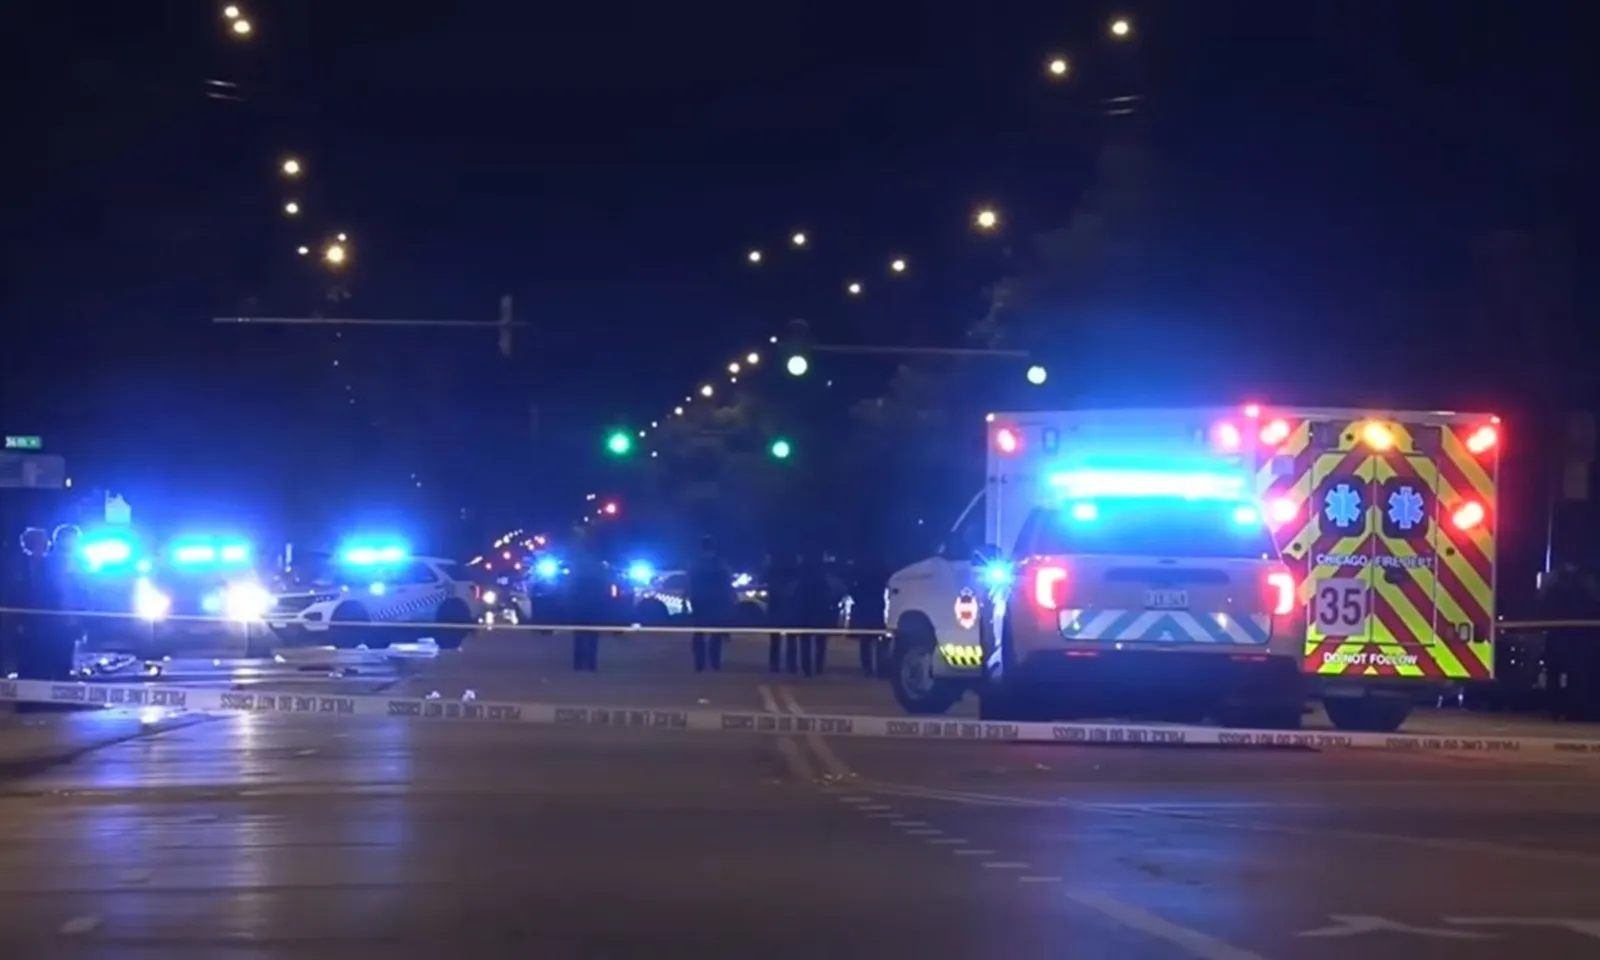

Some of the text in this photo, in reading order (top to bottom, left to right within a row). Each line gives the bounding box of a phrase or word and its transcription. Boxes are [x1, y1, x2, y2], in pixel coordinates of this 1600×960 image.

[1316, 553, 1433, 567] CHICAGO FIRE DEPT
[1319, 587, 1362, 626] 35
[1324, 652, 1418, 665] DO NOT FOLLOW
[220, 693, 354, 714] POLICE LINE DO NOT CROSS
